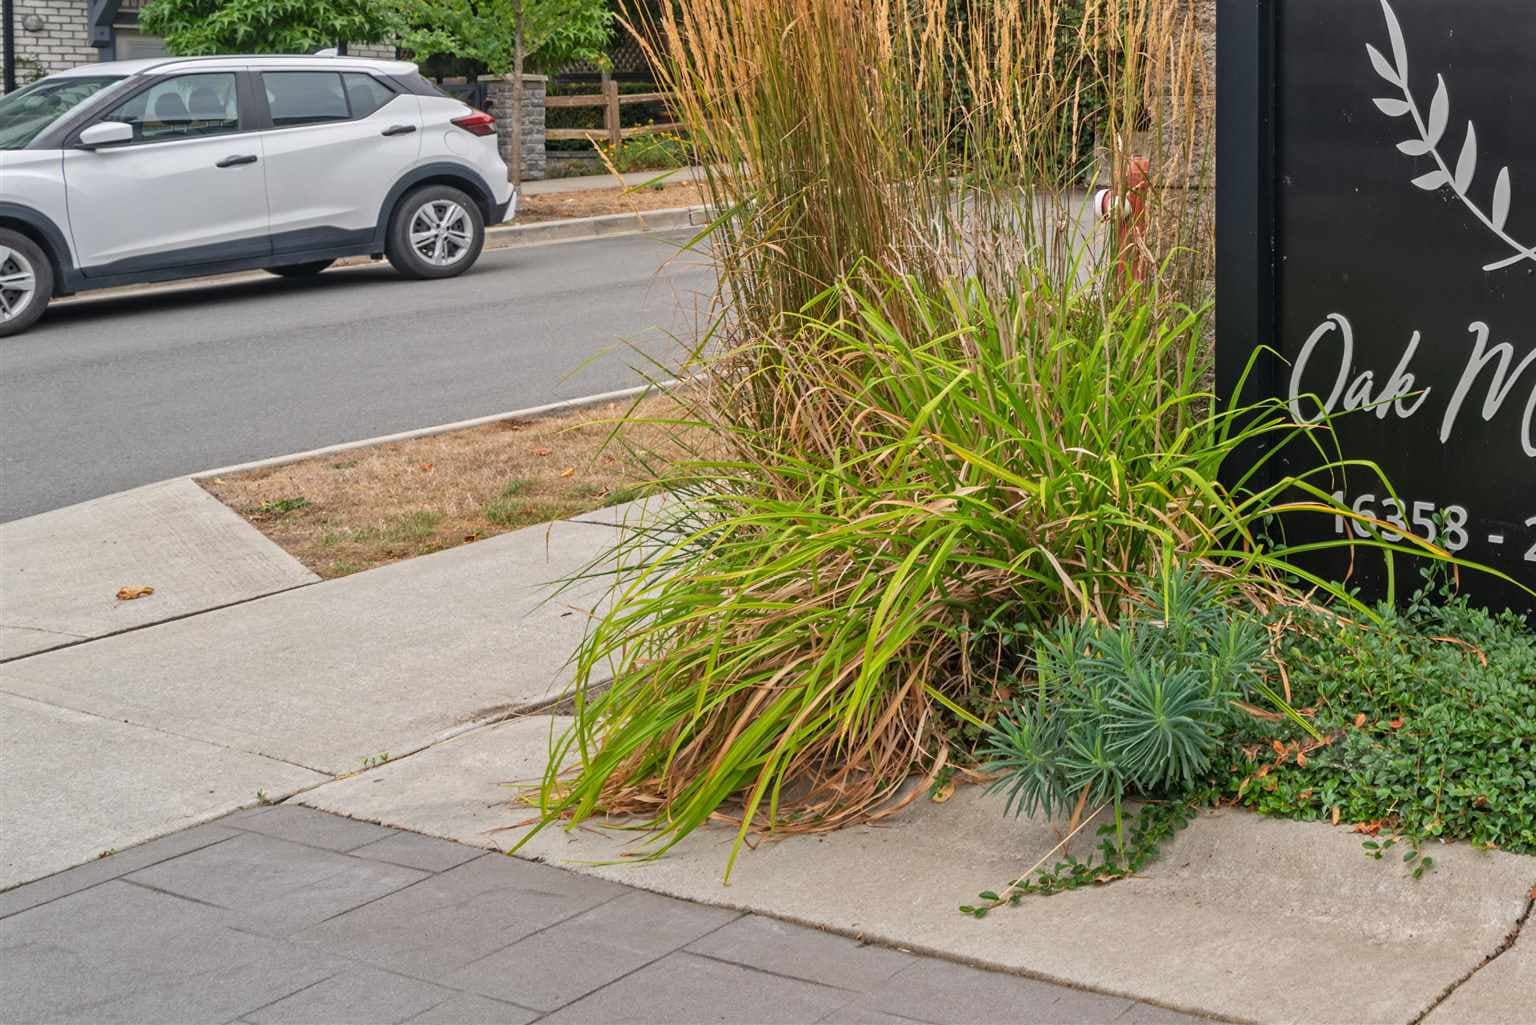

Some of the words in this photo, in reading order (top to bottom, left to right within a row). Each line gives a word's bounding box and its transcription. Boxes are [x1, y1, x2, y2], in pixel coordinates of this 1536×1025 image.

[1288, 313, 1431, 428] Oak
[1332, 490, 1469, 552] 16358
[1488, 534, 1504, 544] -
